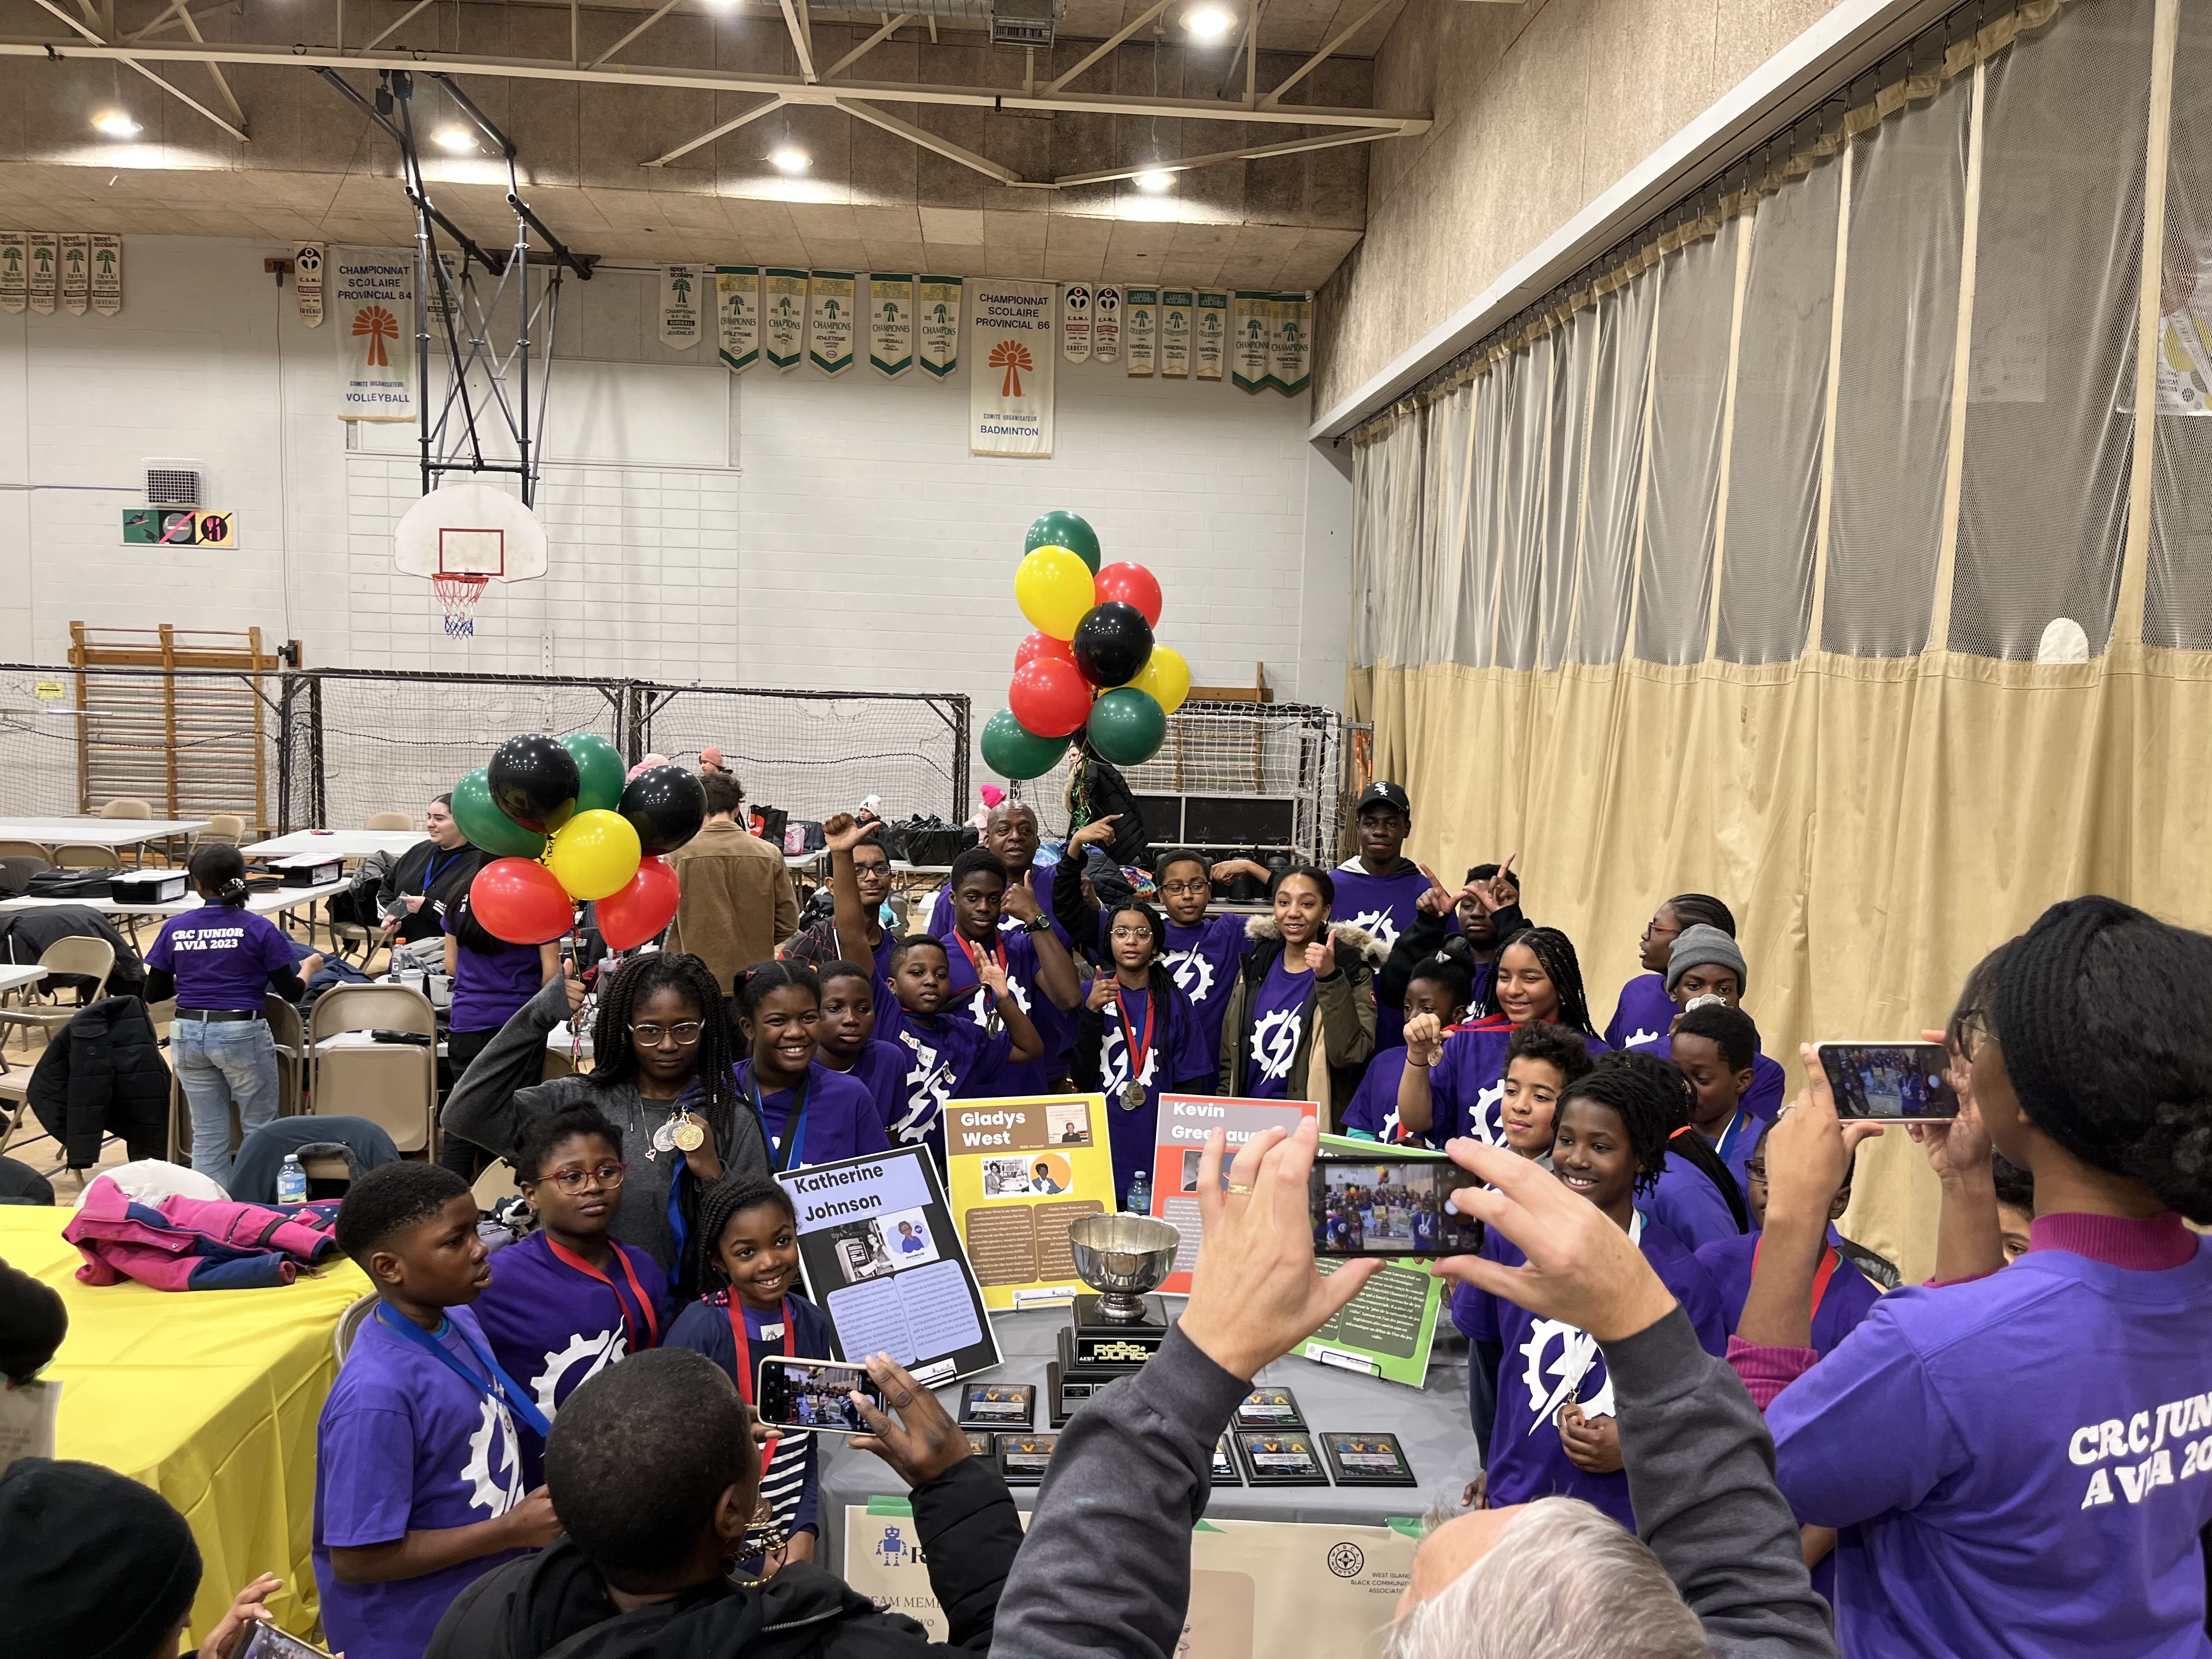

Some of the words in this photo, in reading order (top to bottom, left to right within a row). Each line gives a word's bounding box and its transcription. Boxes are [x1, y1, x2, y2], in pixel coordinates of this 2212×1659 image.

[339, 266, 409, 275] CHAMPIONNAT
[348, 278, 400, 287] SCOLAIRE
[338, 290, 396, 300] PROVINCIAL
[399, 291, 411, 300] 84
[979, 293, 1049, 306] CHAMPIONNAT
[988, 307, 1039, 317] SCOLAIRE
[720, 318, 756, 326] CHAMPIONNES
[813, 320, 851, 330] CHAMPIONS
[975, 318, 1033, 329] PROVINCIAL
[1037, 321, 1050, 329] 86
[872, 324, 910, 332] CHAMPIONNES
[1271, 343, 1308, 352] CHAMPIONS
[346, 393, 410, 403] VOLLEYBALL
[980, 425, 1039, 436] BADMINTON
[172, 929, 196, 940] CRC
[198, 928, 244, 940] JUNIOR
[174, 940, 207, 951] AVIA
[210, 939, 238, 949] 2023
[1173, 1102, 1224, 1118] Kevin
[961, 1110, 1026, 1129] Gladys
[962, 1131, 1011, 1147] West
[794, 1165, 884, 1194] Katherine
[805, 1193, 882, 1222] Johnson
[2069, 1410, 2149, 1465] CRC
[866, 1595, 900, 1607] EAM
